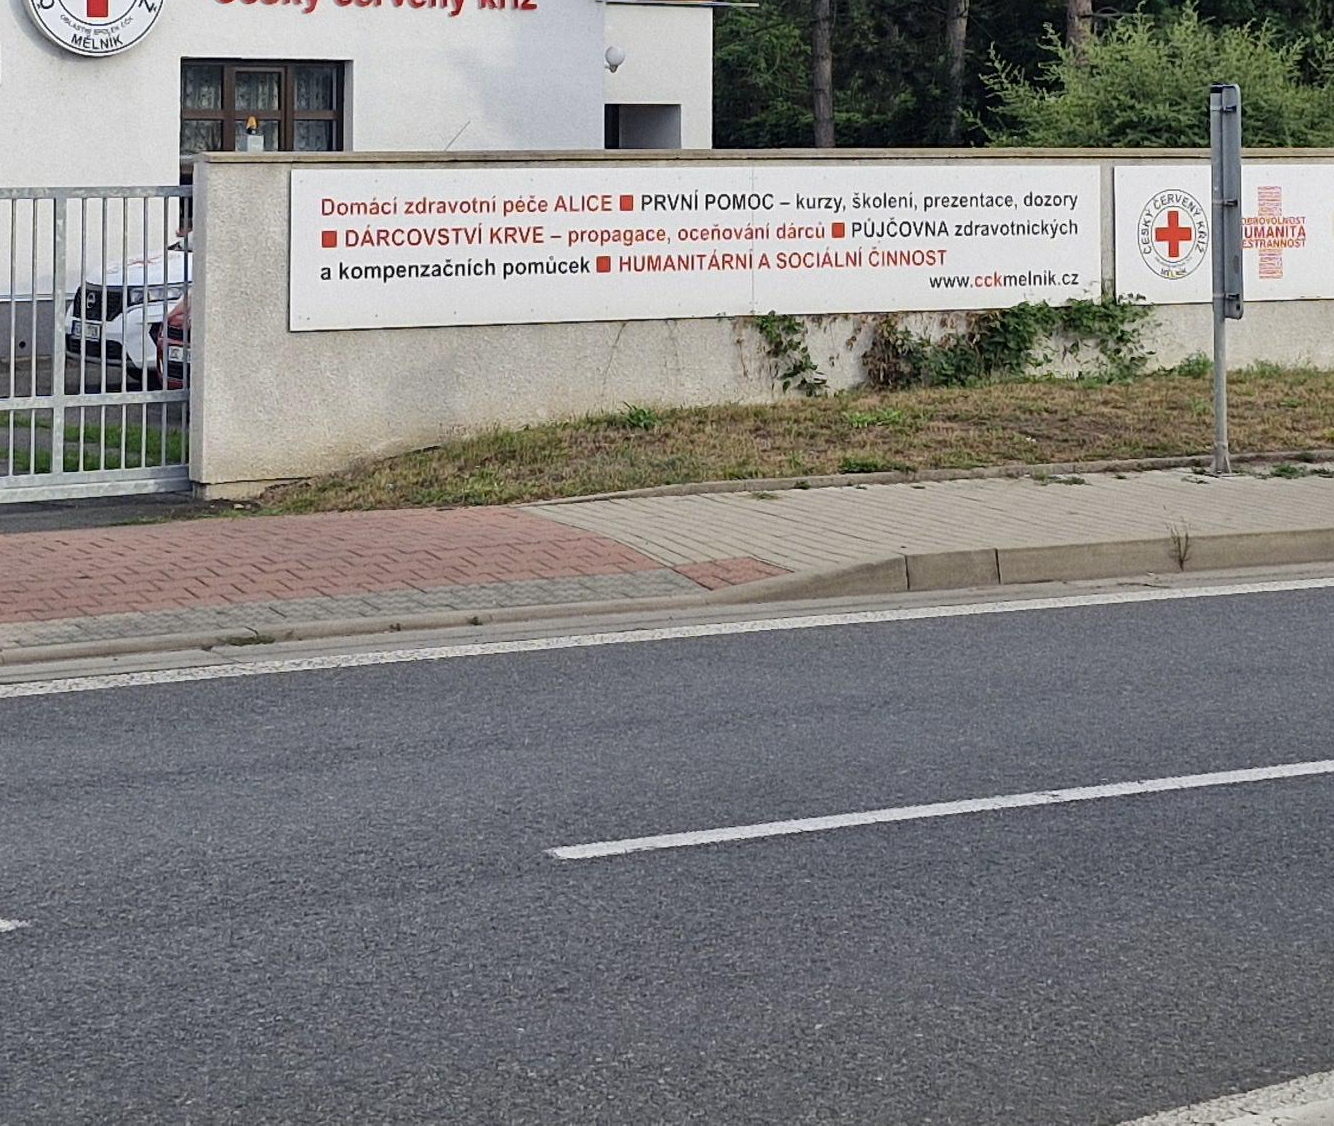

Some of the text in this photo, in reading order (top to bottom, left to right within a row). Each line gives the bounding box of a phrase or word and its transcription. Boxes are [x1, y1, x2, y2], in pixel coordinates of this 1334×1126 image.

[71, 33, 123, 50] MĚLNÍK
[321, 196, 398, 216] Domácí
[404, 194, 497, 215] zdravotní
[503, 194, 549, 217] péče
[554, 194, 613, 213] ALICE
[641, 189, 699, 212] PRVNÍ
[704, 193, 775, 211] POMOC
[795, 193, 847, 214] kurzy,
[851, 192, 918, 212] školení,
[923, 192, 1018, 212] prezentace,
[1023, 191, 1079, 211] dozory
[1240, 216, 1307, 225] OBROVOLNOST
[344, 223, 483, 248] DÁRCOVSTVÍ
[489, 226, 545, 245] KRVE
[567, 228, 671, 248] propagace,
[677, 222, 770, 242] oceňování
[776, 221, 825, 240] dárců
[851, 217, 950, 238] PŮJČOVNA
[954, 219, 1079, 240] zdravotnických
[1241, 225, 1307, 240] UMANITA
[1242, 238, 1307, 249] ESTRANNOST
[320, 246, 948, 284] a kompenzačních pomůcek HUMANITÁRNÍ A SOCIÁLNÍ ČINNOST
[929, 270, 1080, 289] www.cckmelnik.cz
